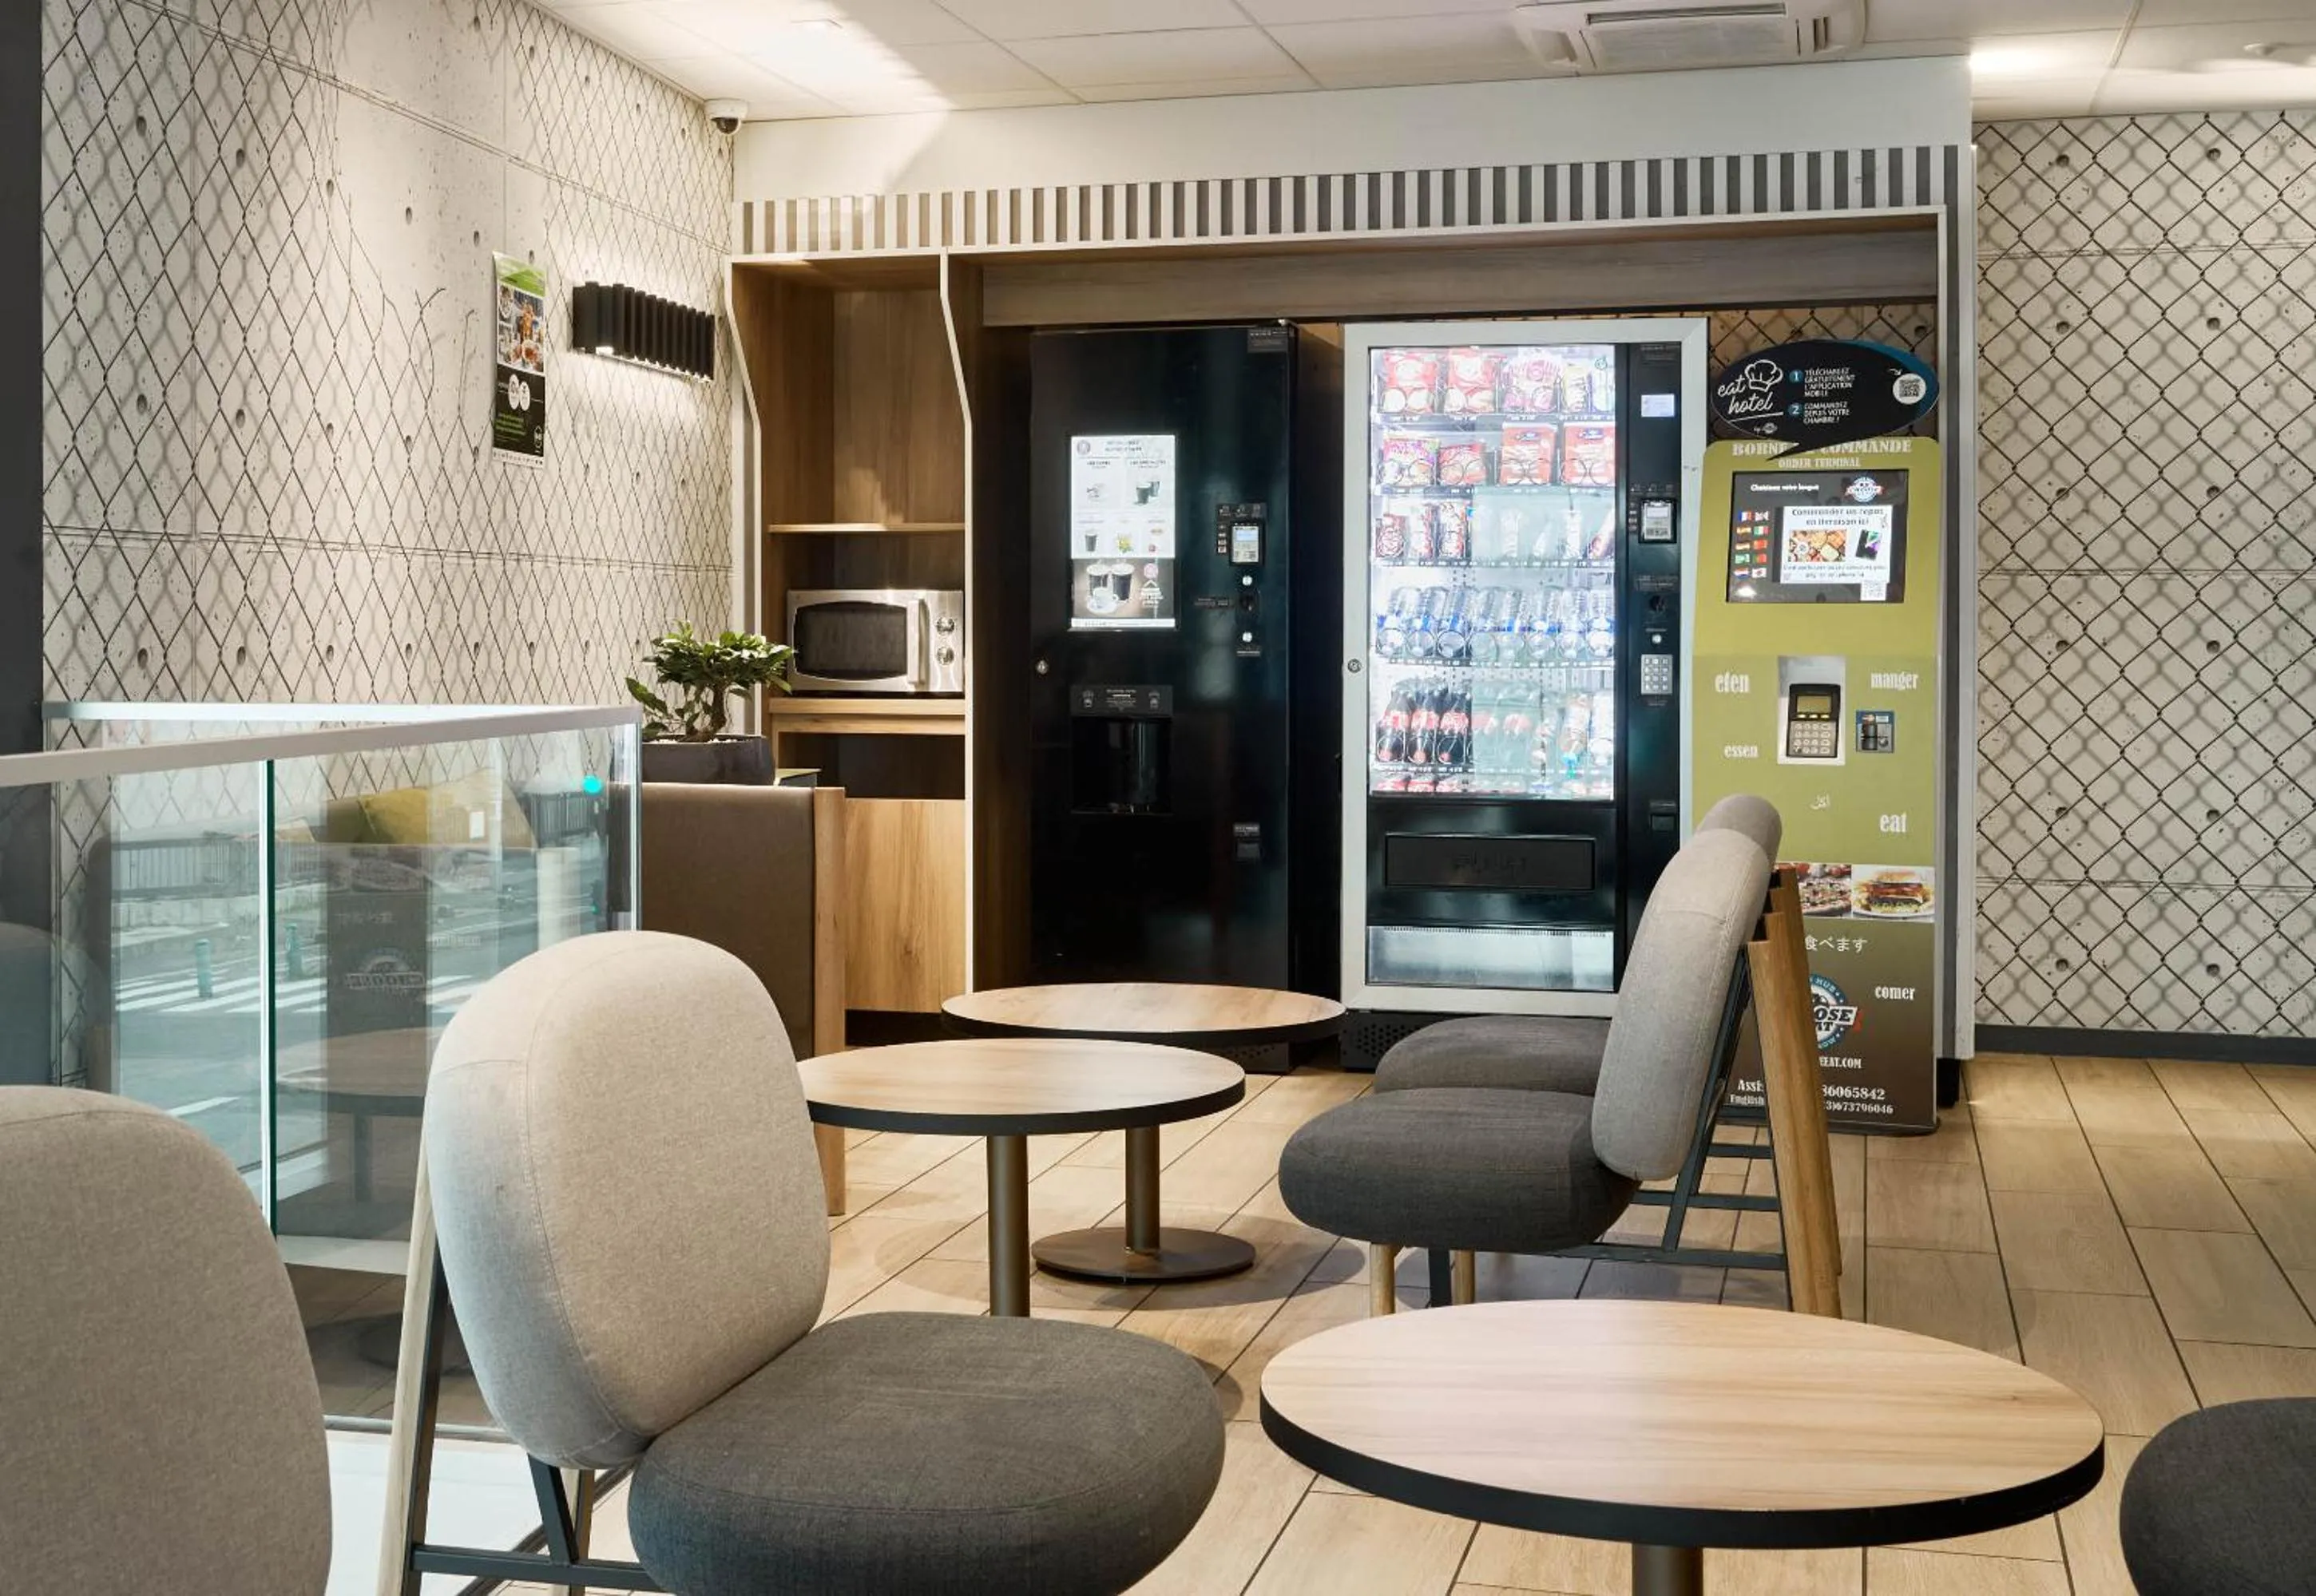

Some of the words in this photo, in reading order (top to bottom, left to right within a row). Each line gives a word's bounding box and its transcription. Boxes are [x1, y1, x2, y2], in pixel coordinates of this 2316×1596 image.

[1718, 374, 1747, 397] eat
[1728, 391, 1773, 414] hotel
[1715, 671, 1750, 693] eten
[1870, 671, 1919, 691] manger
[1723, 743, 1759, 758] essen
[1879, 812, 1907, 833] eat
[1804, 934, 1868, 953] 食べます
[1874, 985, 1916, 1001] comer
[1814, 1008, 1853, 1022] OSE
[1822, 1084, 1885, 1100] 36065842
